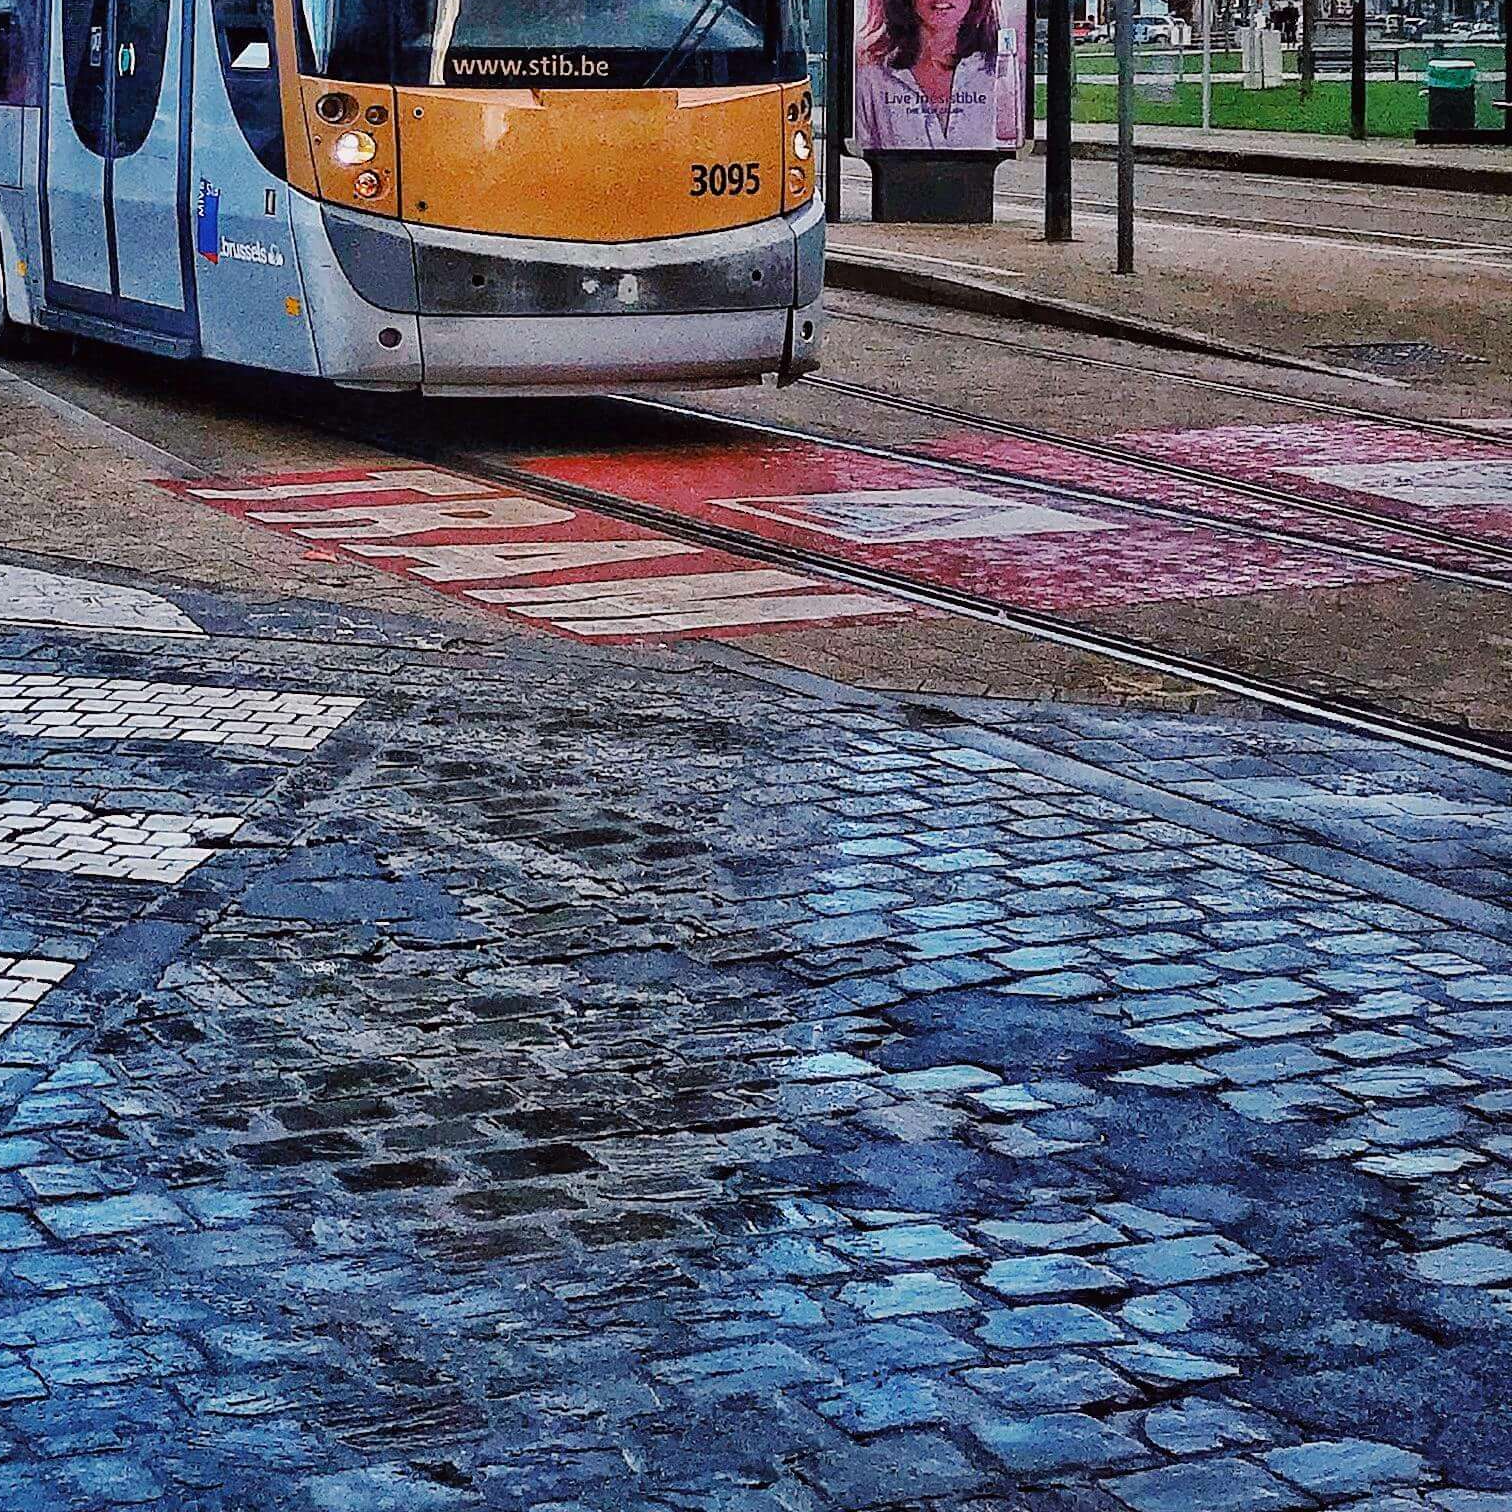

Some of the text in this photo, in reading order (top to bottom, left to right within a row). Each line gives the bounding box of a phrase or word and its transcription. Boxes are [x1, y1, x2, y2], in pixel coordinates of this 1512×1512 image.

[452, 55, 609, 76] www.stib.be
[885, 91, 912, 104] Live
[689, 163, 760, 196] 3095
[186, 468, 914, 638] TRAM
